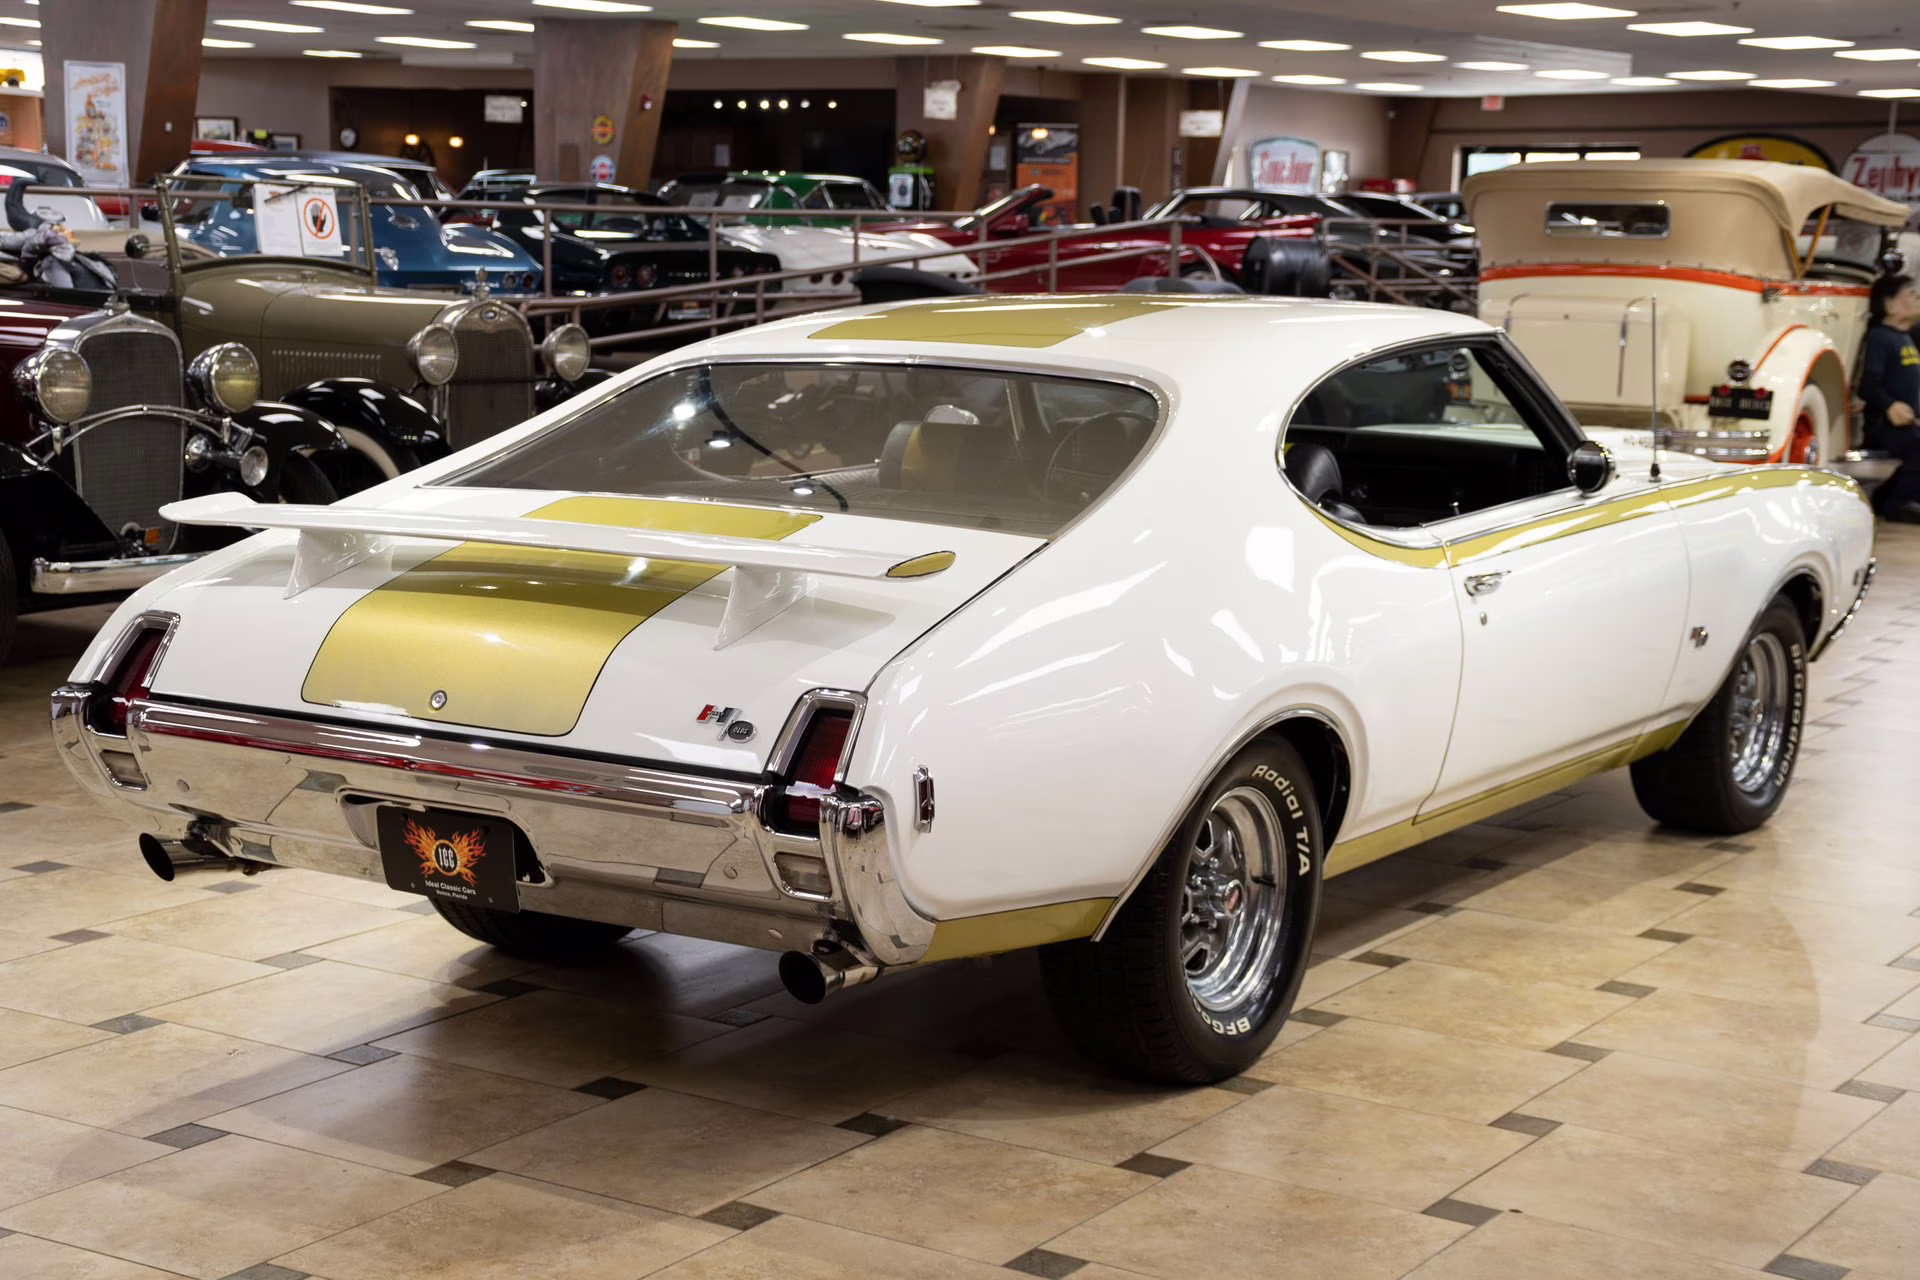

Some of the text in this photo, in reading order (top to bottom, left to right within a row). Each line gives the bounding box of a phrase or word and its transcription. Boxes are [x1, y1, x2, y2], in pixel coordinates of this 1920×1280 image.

[1251, 764, 1311, 877] Radial T/A
[438, 847, 455, 868] ICC
[425, 879, 476, 895] Ideal Classic Cars
[436, 889, 468, 900] Venice, Florida
